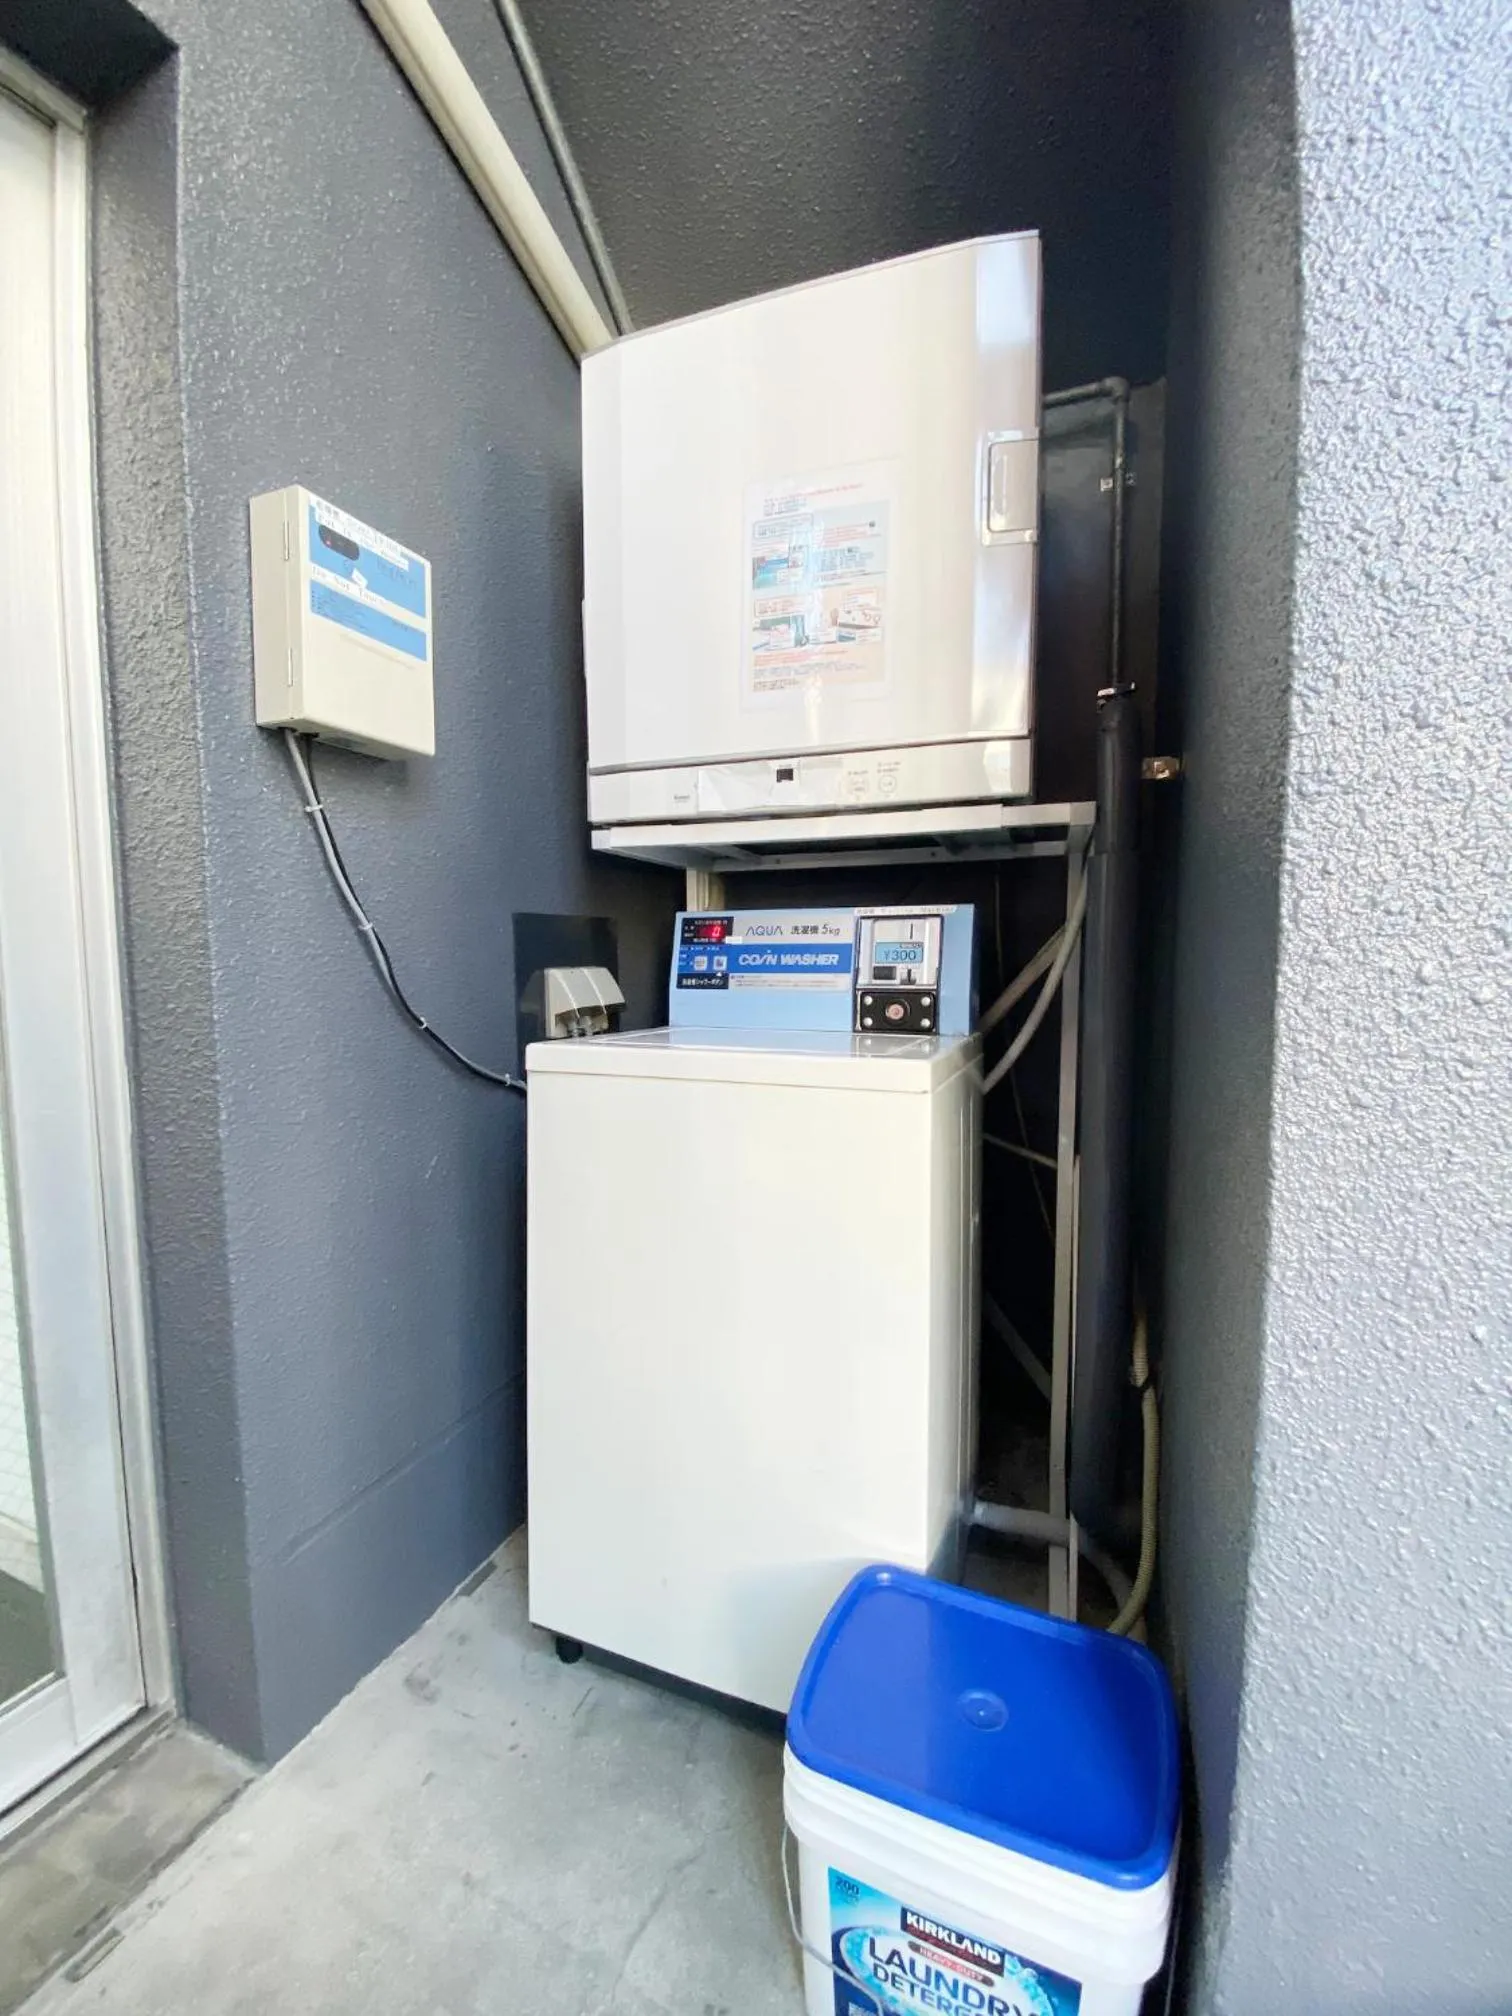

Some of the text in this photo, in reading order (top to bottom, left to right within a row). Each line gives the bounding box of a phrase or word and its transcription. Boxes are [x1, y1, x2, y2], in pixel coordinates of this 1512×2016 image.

[745, 925, 783, 936] AQUA
[822, 924, 841, 936] 5kg
[780, 953, 840, 966] WASHER
[836, 1876, 860, 1896] 200
[906, 1910, 1002, 1965] KIRKLAND
[873, 1962, 984, 2016] DETERG
